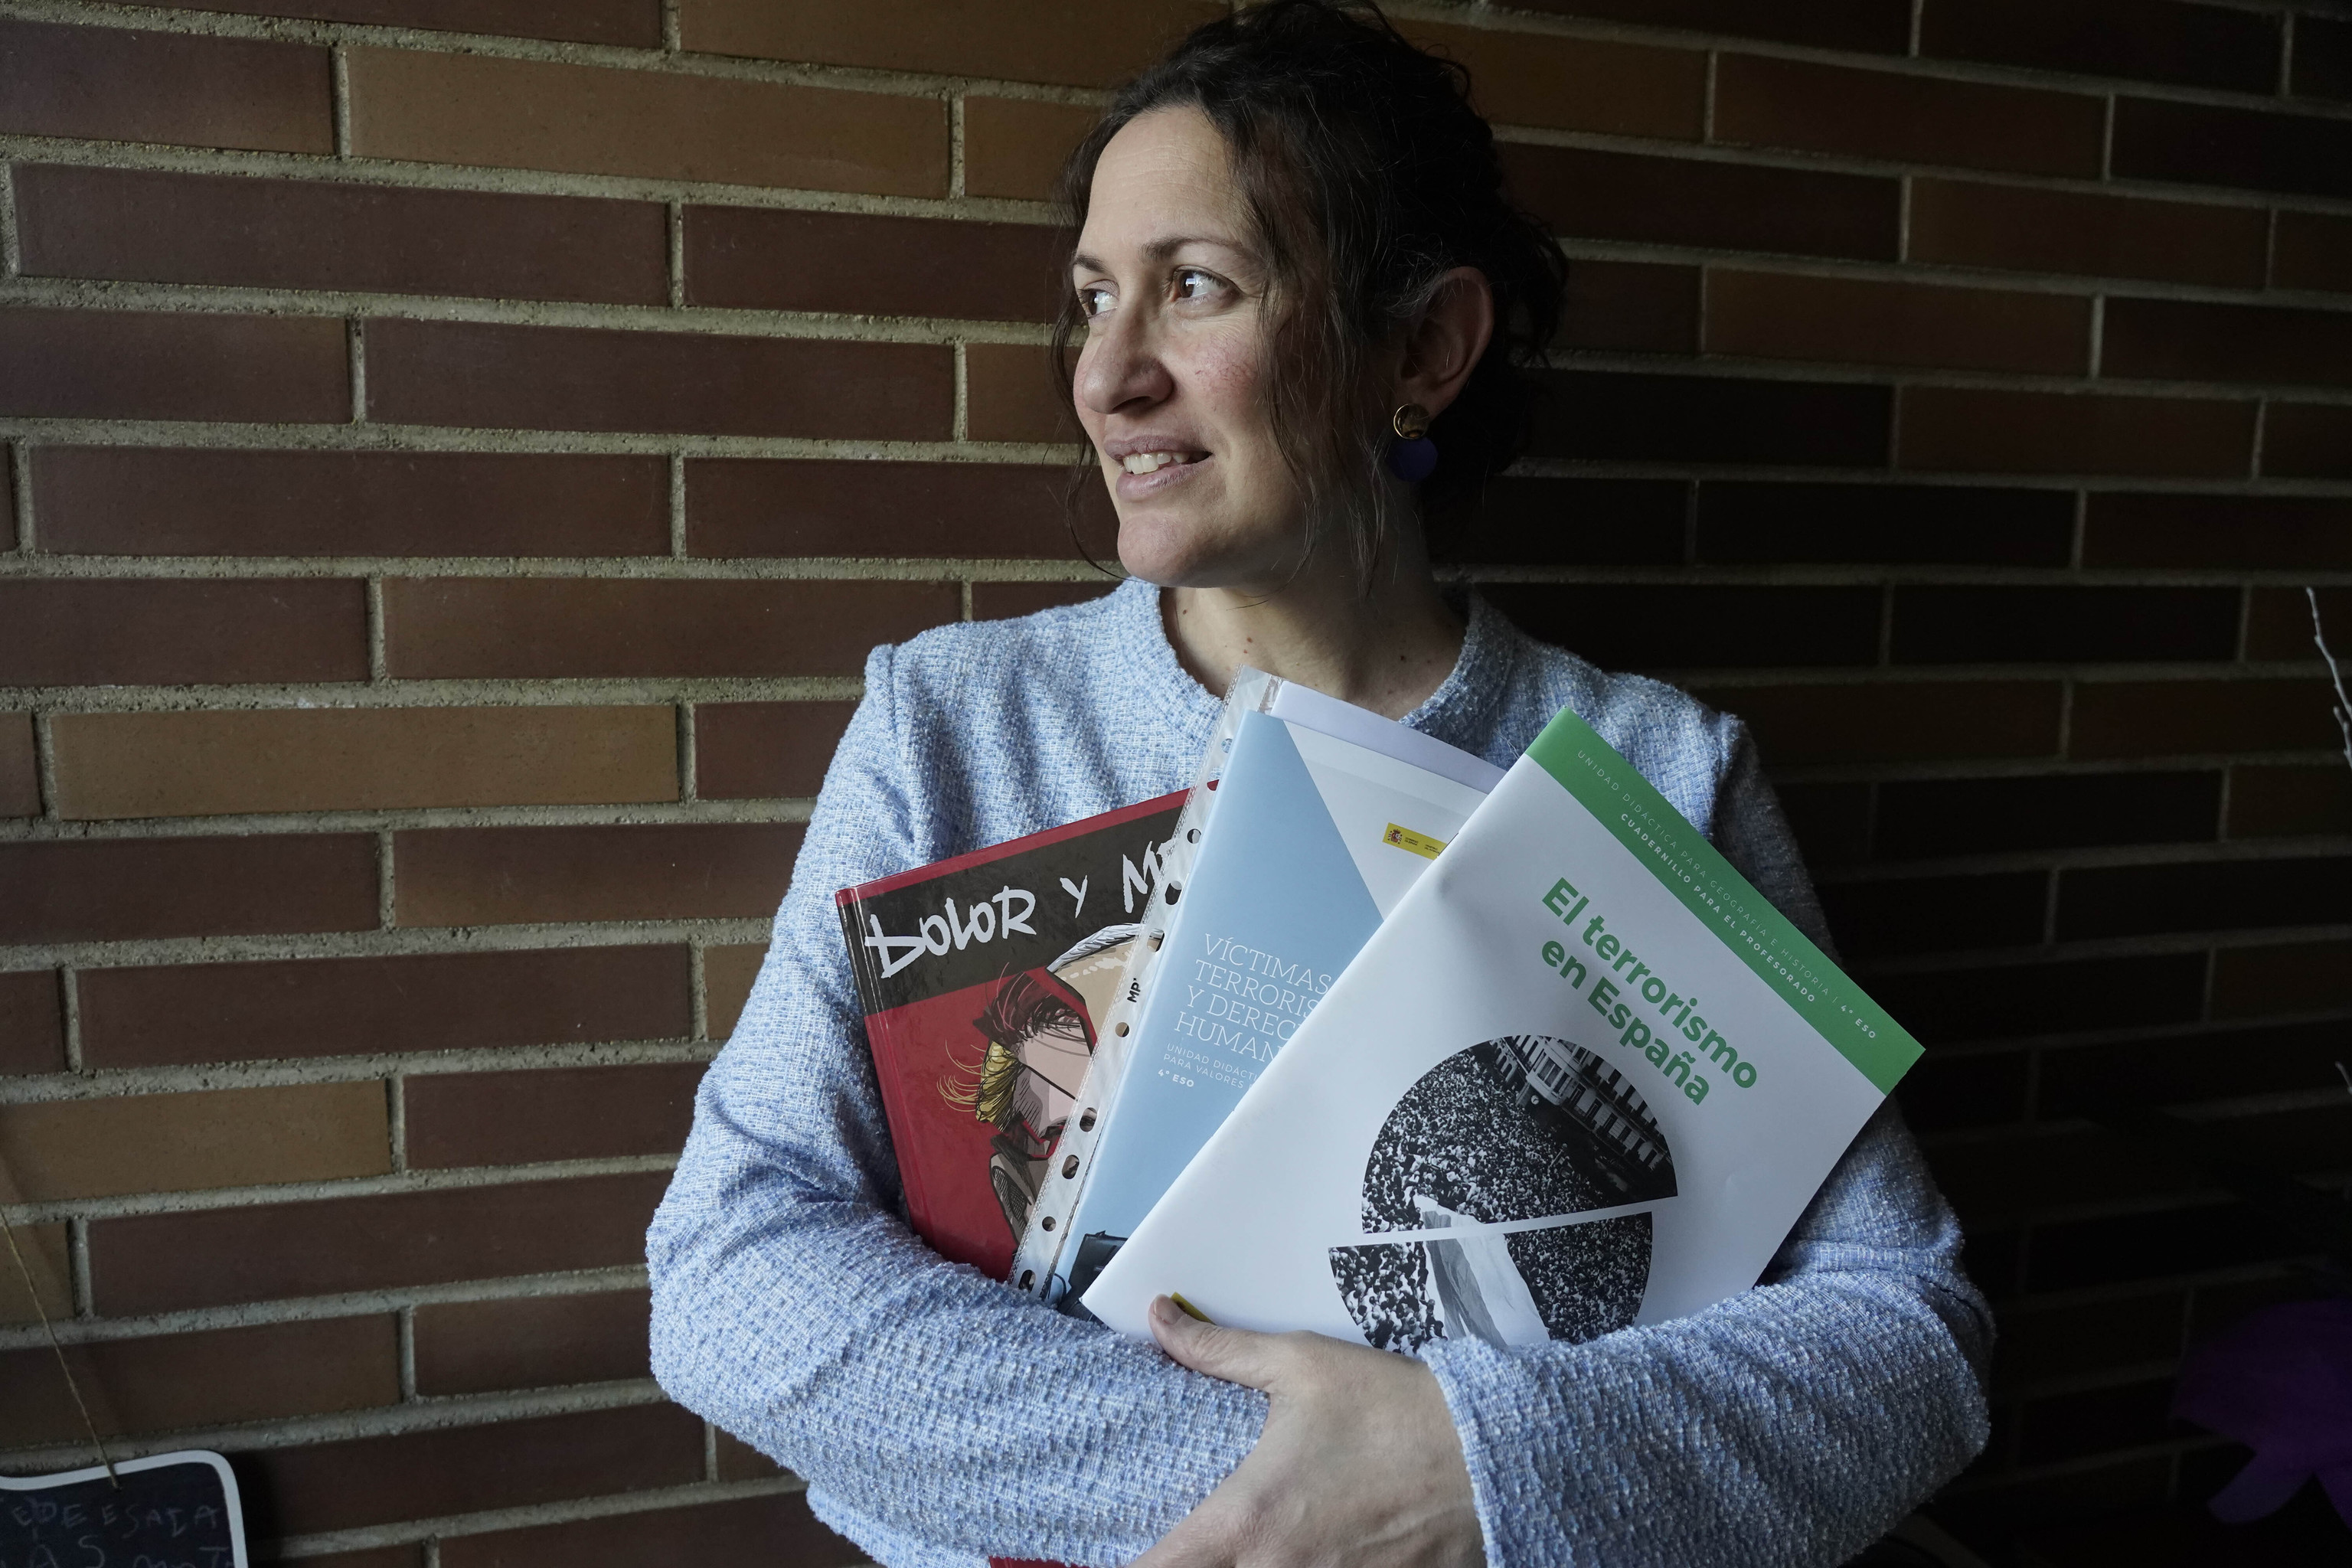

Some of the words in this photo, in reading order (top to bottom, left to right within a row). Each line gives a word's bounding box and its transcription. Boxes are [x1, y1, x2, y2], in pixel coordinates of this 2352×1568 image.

[1577, 750, 1619, 791] UNIDAD
[1622, 793, 1677, 849] DIDÁCTICA
[1681, 851, 1706, 878] PARA
[1710, 880, 1766, 937] GEOGRAFÍA
[1770, 938, 1778, 947] E
[1781, 948, 1829, 995] HISTORIA
[1855, 1018, 1876, 1038] ESO
[1621, 813, 1690, 883] CUADERNILLO
[1694, 885, 1720, 913] PARA
[1723, 915, 1736, 929] EL
[1740, 929, 1815, 1001] PROFESORADO
[1204, 933, 1332, 995] VÍCTIMAS
[1541, 877, 1589, 926] El
[1582, 915, 1758, 1089] terrorismo
[1187, 985, 1205, 1008] Y
[1207, 993, 1303, 1042] DEREC
[1541, 940, 1587, 990] en
[1587, 975, 1710, 1106] España
[1163, 1054, 1191, 1070] PARA
[1196, 1065, 1244, 1089] VALORES
[1167, 1043, 1210, 1064] UNIDAD
[1172, 1073, 1194, 1087] ESO
